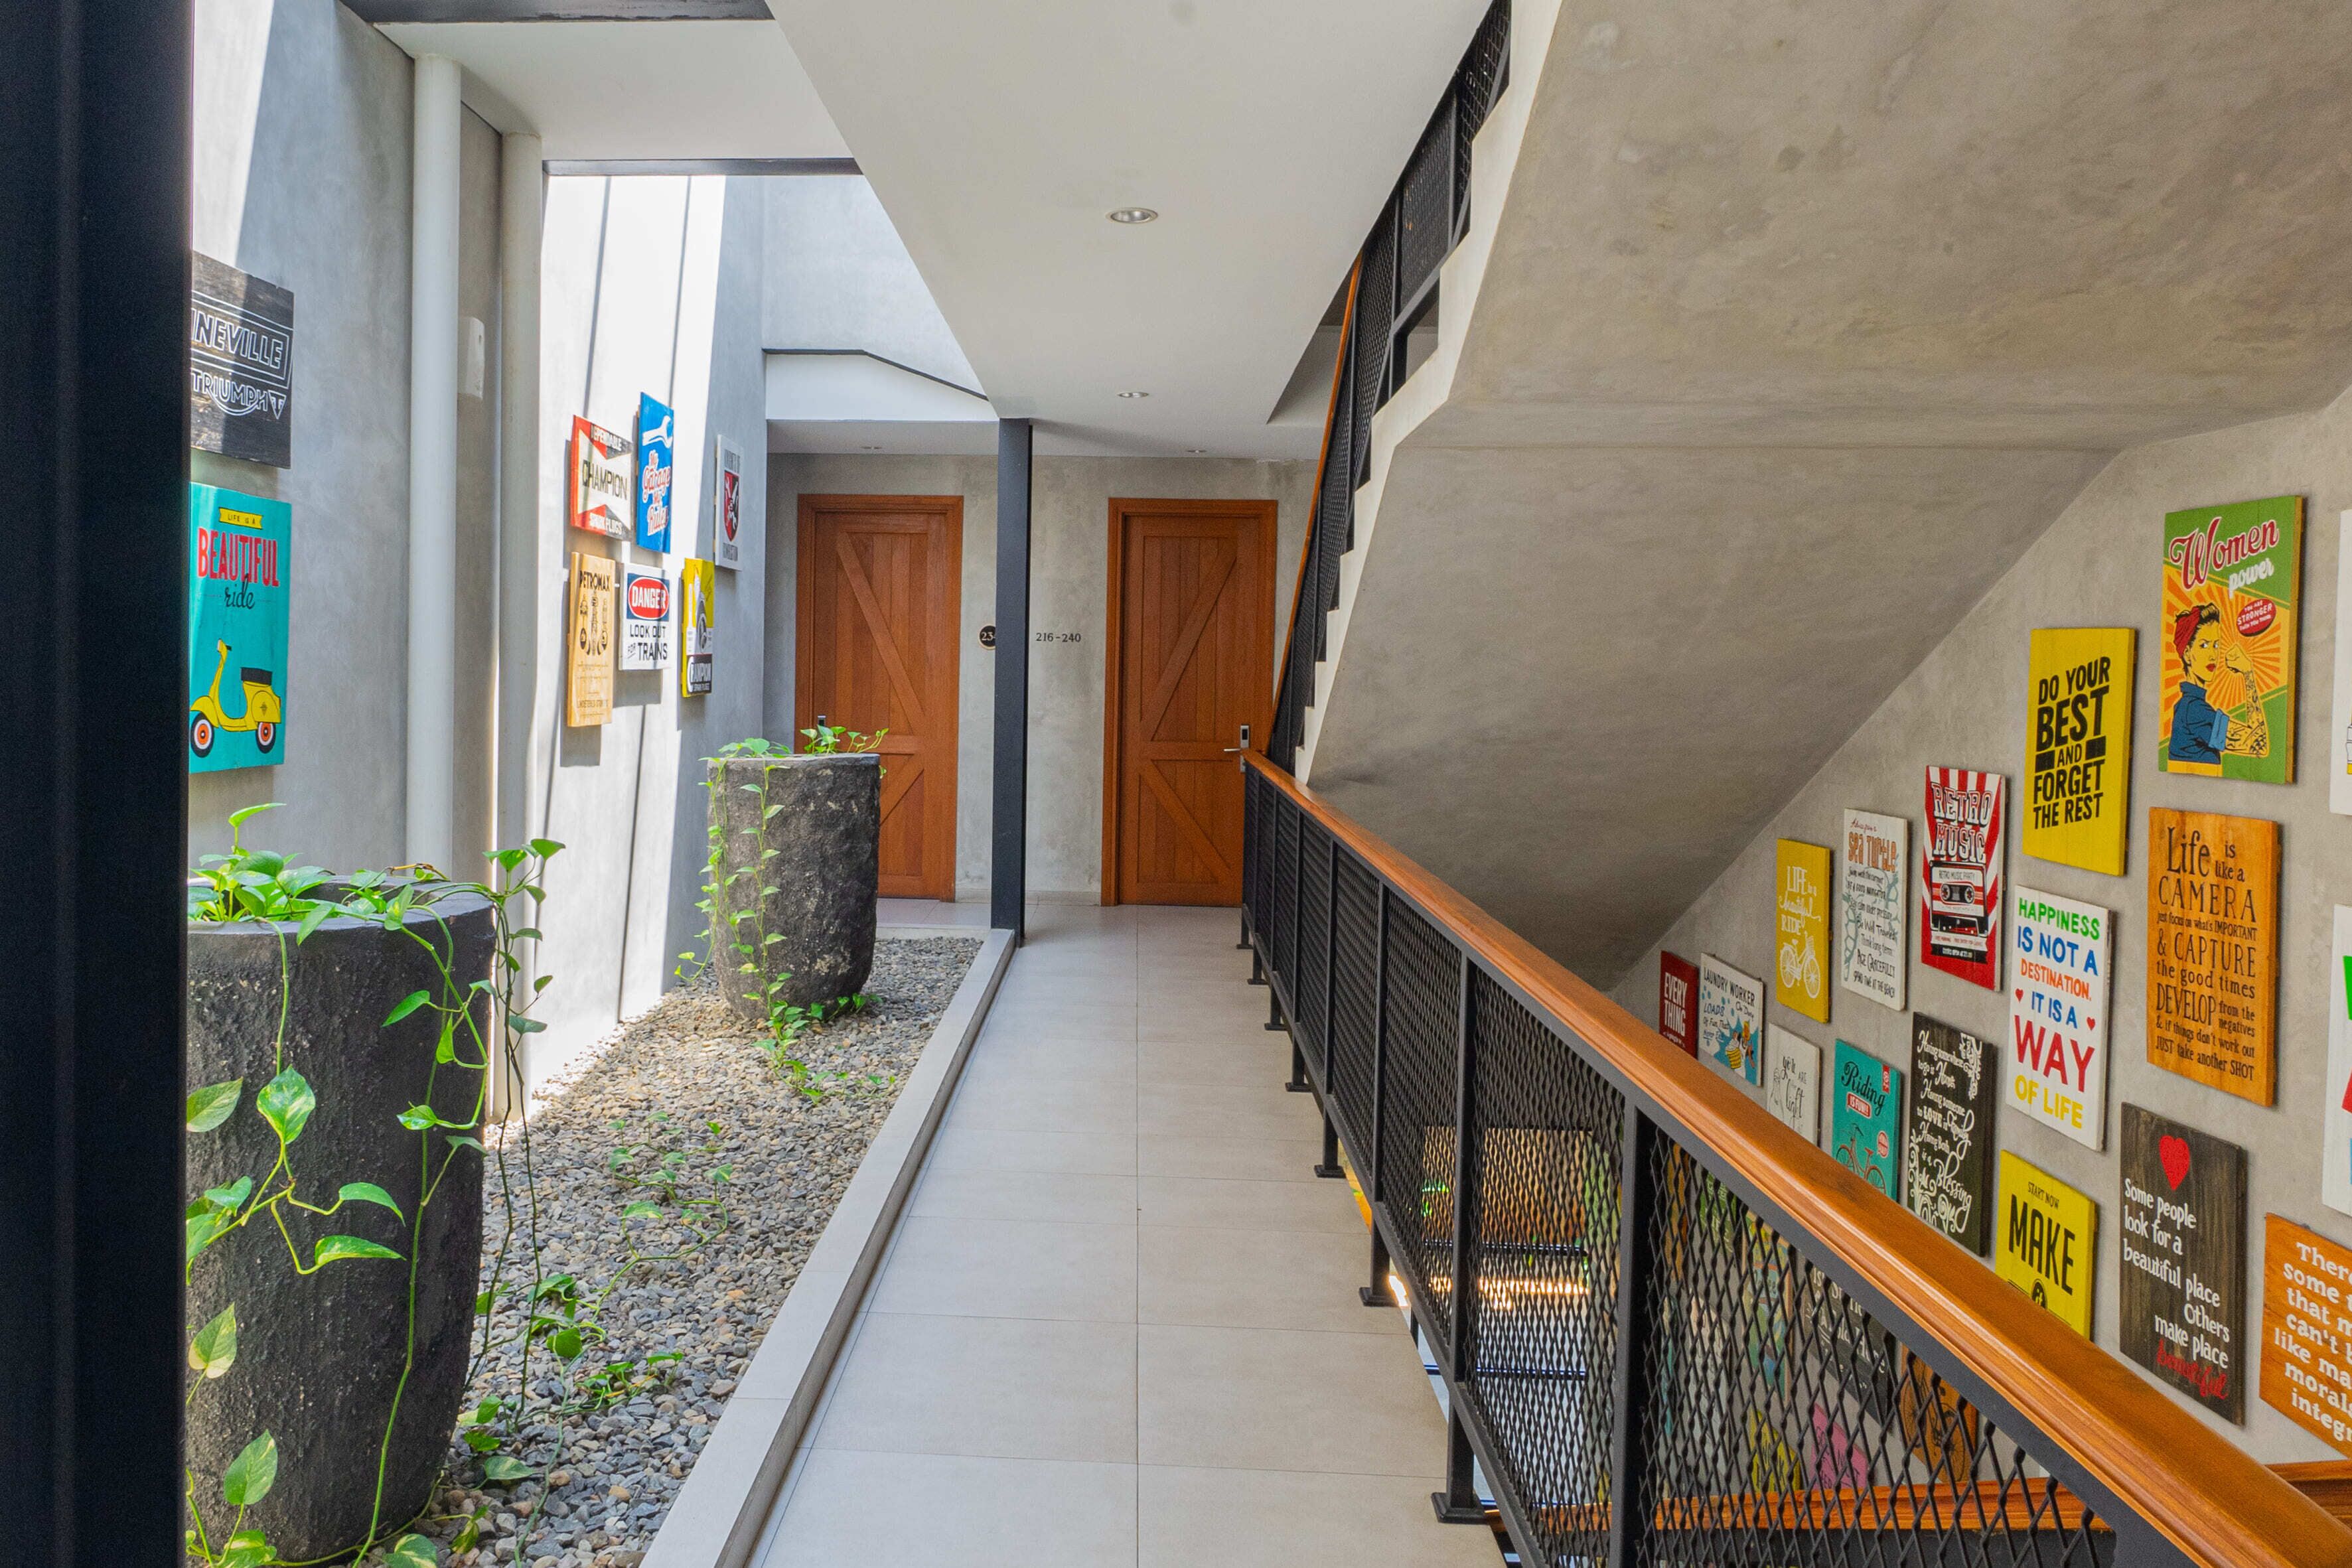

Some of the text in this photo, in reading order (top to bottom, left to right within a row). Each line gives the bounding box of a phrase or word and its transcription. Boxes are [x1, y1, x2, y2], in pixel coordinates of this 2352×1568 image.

[190, 308, 283, 369] NEVILLE
[190, 370, 268, 416] TRIUMPH
[582, 459, 627, 500] CHAMPION
[228, 513, 240, 522] LIFE
[198, 527, 279, 587] BEAUTIFUL
[2168, 516, 2279, 591] Women
[224, 573, 256, 609] ride
[579, 570, 611, 592] PETROMAX
[632, 585, 666, 610] DANGER
[2229, 557, 2274, 599] power
[630, 624, 666, 638] LOOK OUT
[2237, 603, 2272, 625] STRONGER
[637, 642, 668, 661] TRAINS
[981, 631, 995, 641] 23
[2038, 656, 2111, 705] DO YOUR
[2036, 684, 2109, 752] BEST
[2057, 743, 2083, 767] AND
[2033, 759, 2105, 804] FORGET
[1931, 781, 1992, 827] RETRO
[2033, 792, 2103, 829] THE REST
[1933, 821, 1986, 863] MUSIC
[2167, 826, 2236, 878] Life is
[1787, 865, 1807, 895] LIFE
[2215, 860, 2245, 883] like a
[2019, 898, 2100, 940] HAPPINESS
[2158, 875, 2256, 922] CAMERA
[1781, 914, 1801, 935] RIDE
[2214, 919, 2256, 942] IMPORTANT
[2018, 926, 2098, 976] IS NOT A
[2157, 928, 2256, 978] & CAPTURE
[1664, 971, 1688, 1009] EVERY
[1704, 966, 1755, 1007] LAUNDRY WORKER
[2021, 958, 2091, 1000] DESTINATION.
[2156, 960, 2255, 999] the good times
[1664, 999, 1686, 1037] THING
[1704, 1003, 1725, 1017] LOADS
[2031, 991, 2077, 1029] IT IS A
[2156, 982, 2255, 1026] DEVELOP from the
[2156, 1015, 2254, 1058] & if things don't work out
[2219, 1018, 2254, 1037] negatives
[2015, 1015, 2095, 1093] WAY
[2156, 1035, 2254, 1081] JUST take another SHOT
[1841, 1062, 1885, 1116] Riding
[2015, 1075, 2083, 1129] OF LIFE
[1923, 1105, 1943, 1127] LOVE
[1933, 1151, 1972, 1234] Blessing
[2028, 1182, 2059, 1210] START NOW
[2124, 1178, 2197, 1230] Some people
[2009, 1194, 2075, 1296] MAKE
[2124, 1205, 2183, 1255] look for a
[2123, 1239, 2221, 1308] beautiful place
[2283, 1263, 2339, 1304] some
[2184, 1303, 2230, 1344] Others
[2286, 1287, 2331, 1325] that
[2155, 1314, 2229, 1370] make place
[2274, 1328, 2311, 1364] like
[2286, 1313, 2338, 1355] can't
